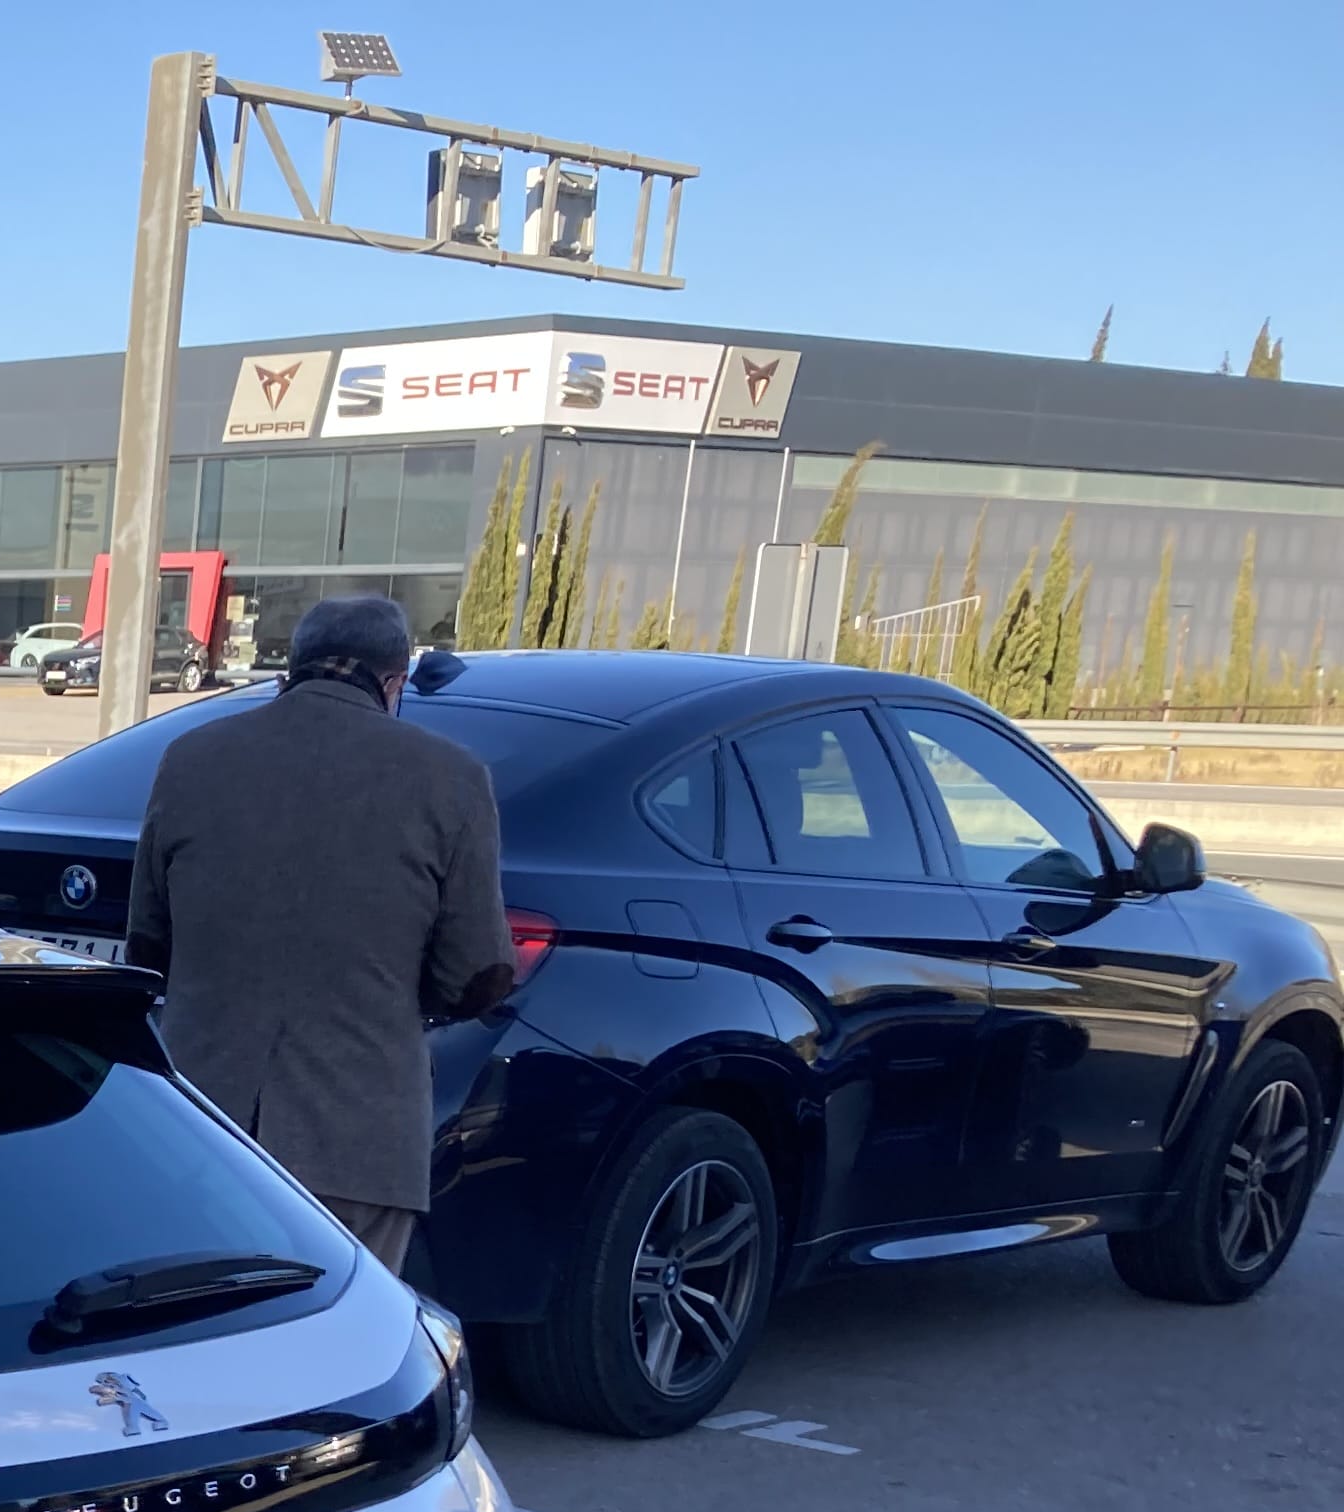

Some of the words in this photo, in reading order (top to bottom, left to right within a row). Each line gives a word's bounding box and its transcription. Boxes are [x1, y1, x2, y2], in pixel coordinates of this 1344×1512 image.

[402, 368, 530, 400] SEAT
[612, 371, 709, 400] SEAT
[229, 421, 305, 435] CUPRA
[717, 417, 779, 432] CUPRA
